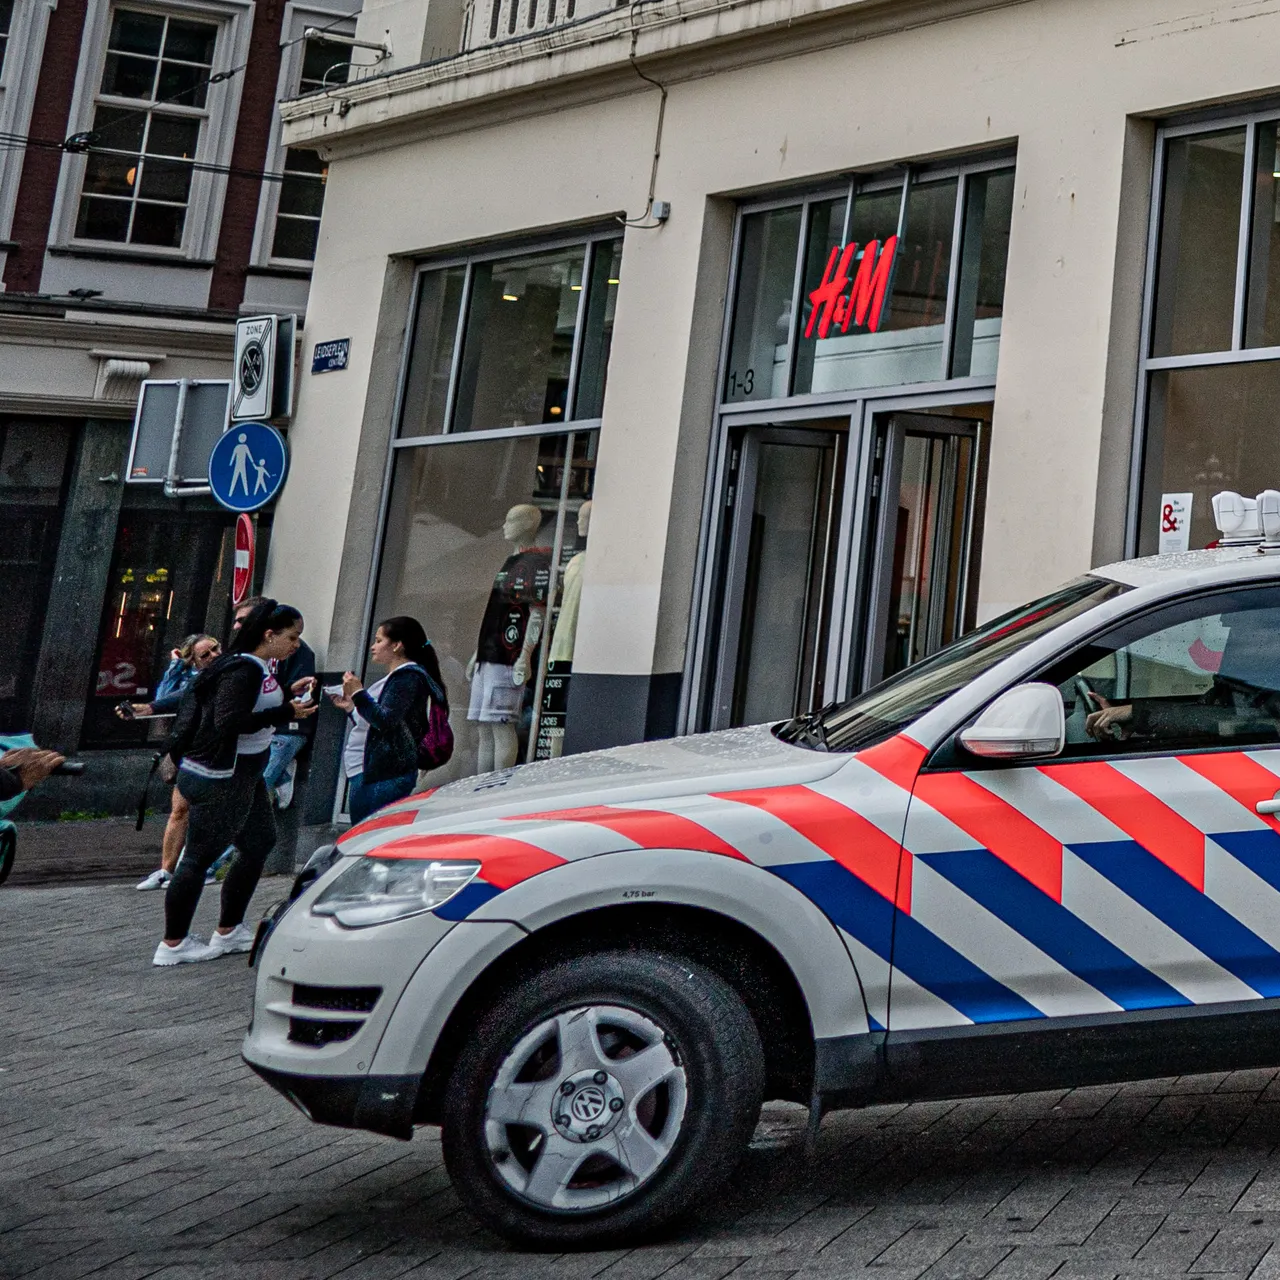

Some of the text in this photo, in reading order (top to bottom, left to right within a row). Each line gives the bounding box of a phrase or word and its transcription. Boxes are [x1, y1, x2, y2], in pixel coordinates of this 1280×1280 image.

[804, 235, 898, 339] H&M
[246, 325, 262, 335] ZONE
[730, 369, 754, 396] 1-3
[622, 890, 640, 898] 4,75
